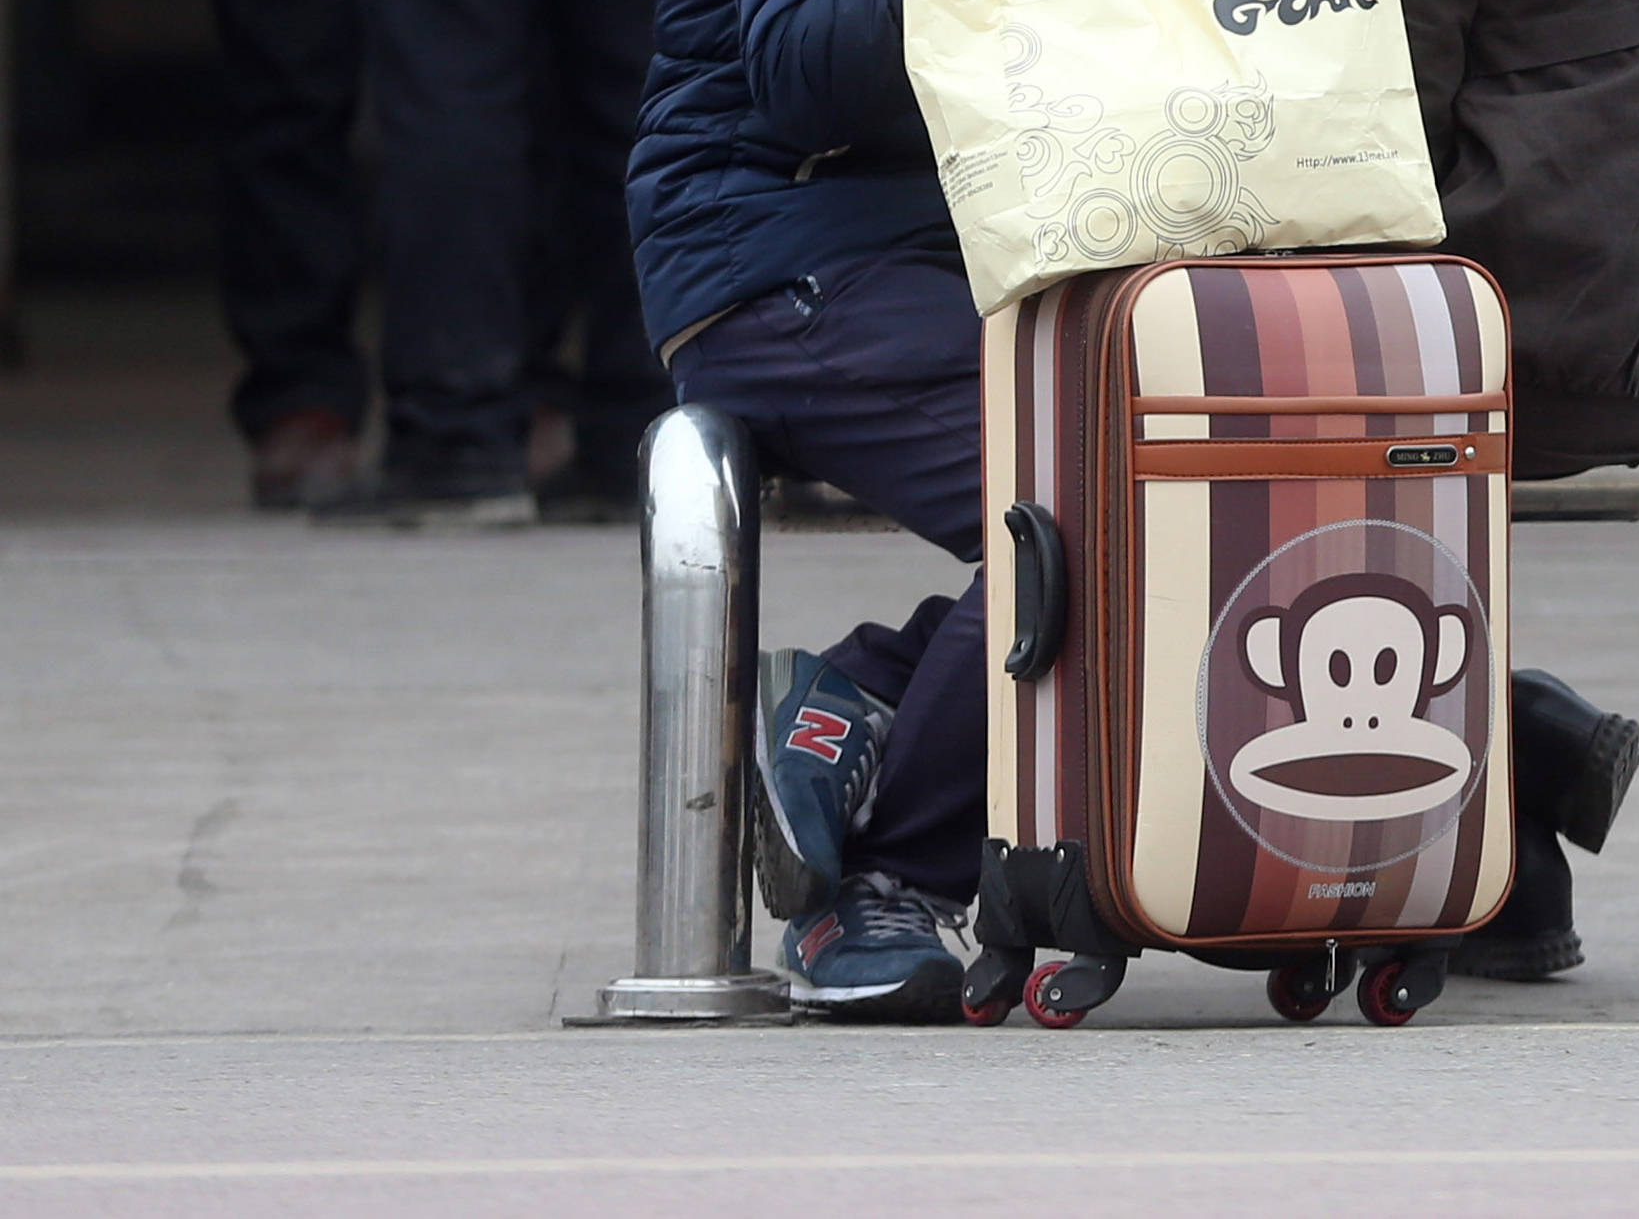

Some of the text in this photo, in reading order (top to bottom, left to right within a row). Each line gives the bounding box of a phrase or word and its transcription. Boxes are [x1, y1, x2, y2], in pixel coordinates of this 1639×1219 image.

[1396, 452, 1419, 461] MING
[785, 706, 852, 765] N
[1307, 881, 1377, 899] FASHION
[797, 912, 845, 970] N
